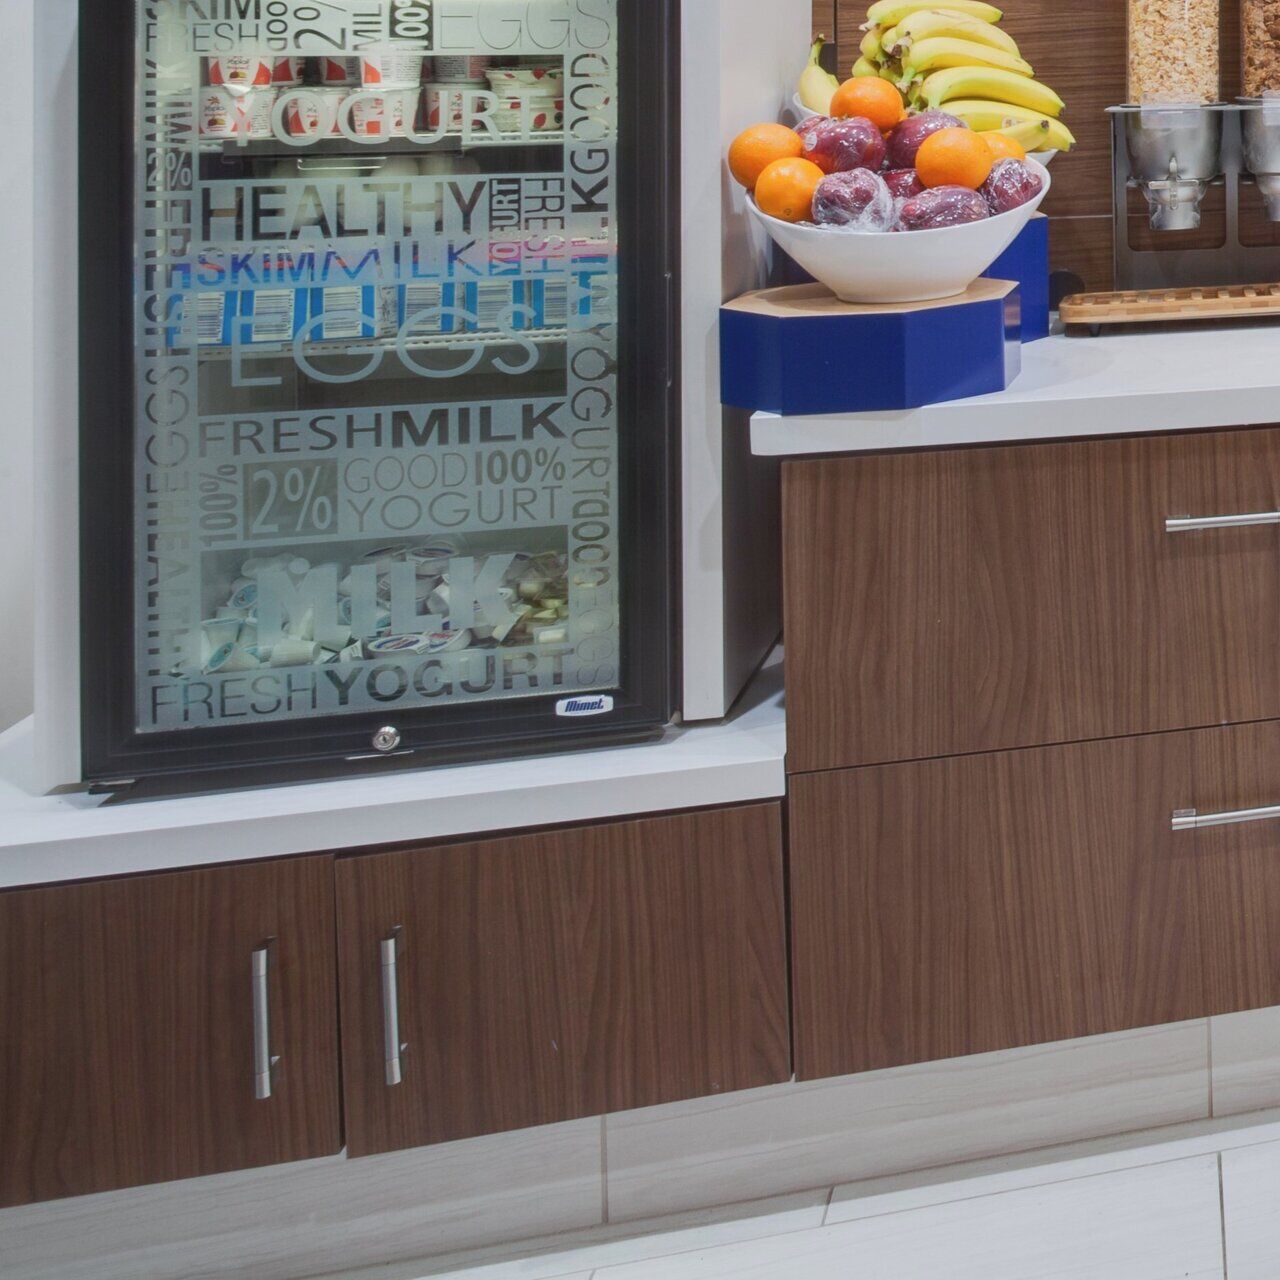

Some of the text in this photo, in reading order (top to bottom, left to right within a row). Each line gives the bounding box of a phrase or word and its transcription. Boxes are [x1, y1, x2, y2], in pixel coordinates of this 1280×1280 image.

[219, 87, 546, 148] YOGURT
[202, 180, 486, 243] HEALTHY
[231, 303, 540, 388] EGGS
[252, 465, 332, 534] 2%
[348, 485, 564, 532] YOGURT
[256, 552, 518, 647] MILK
